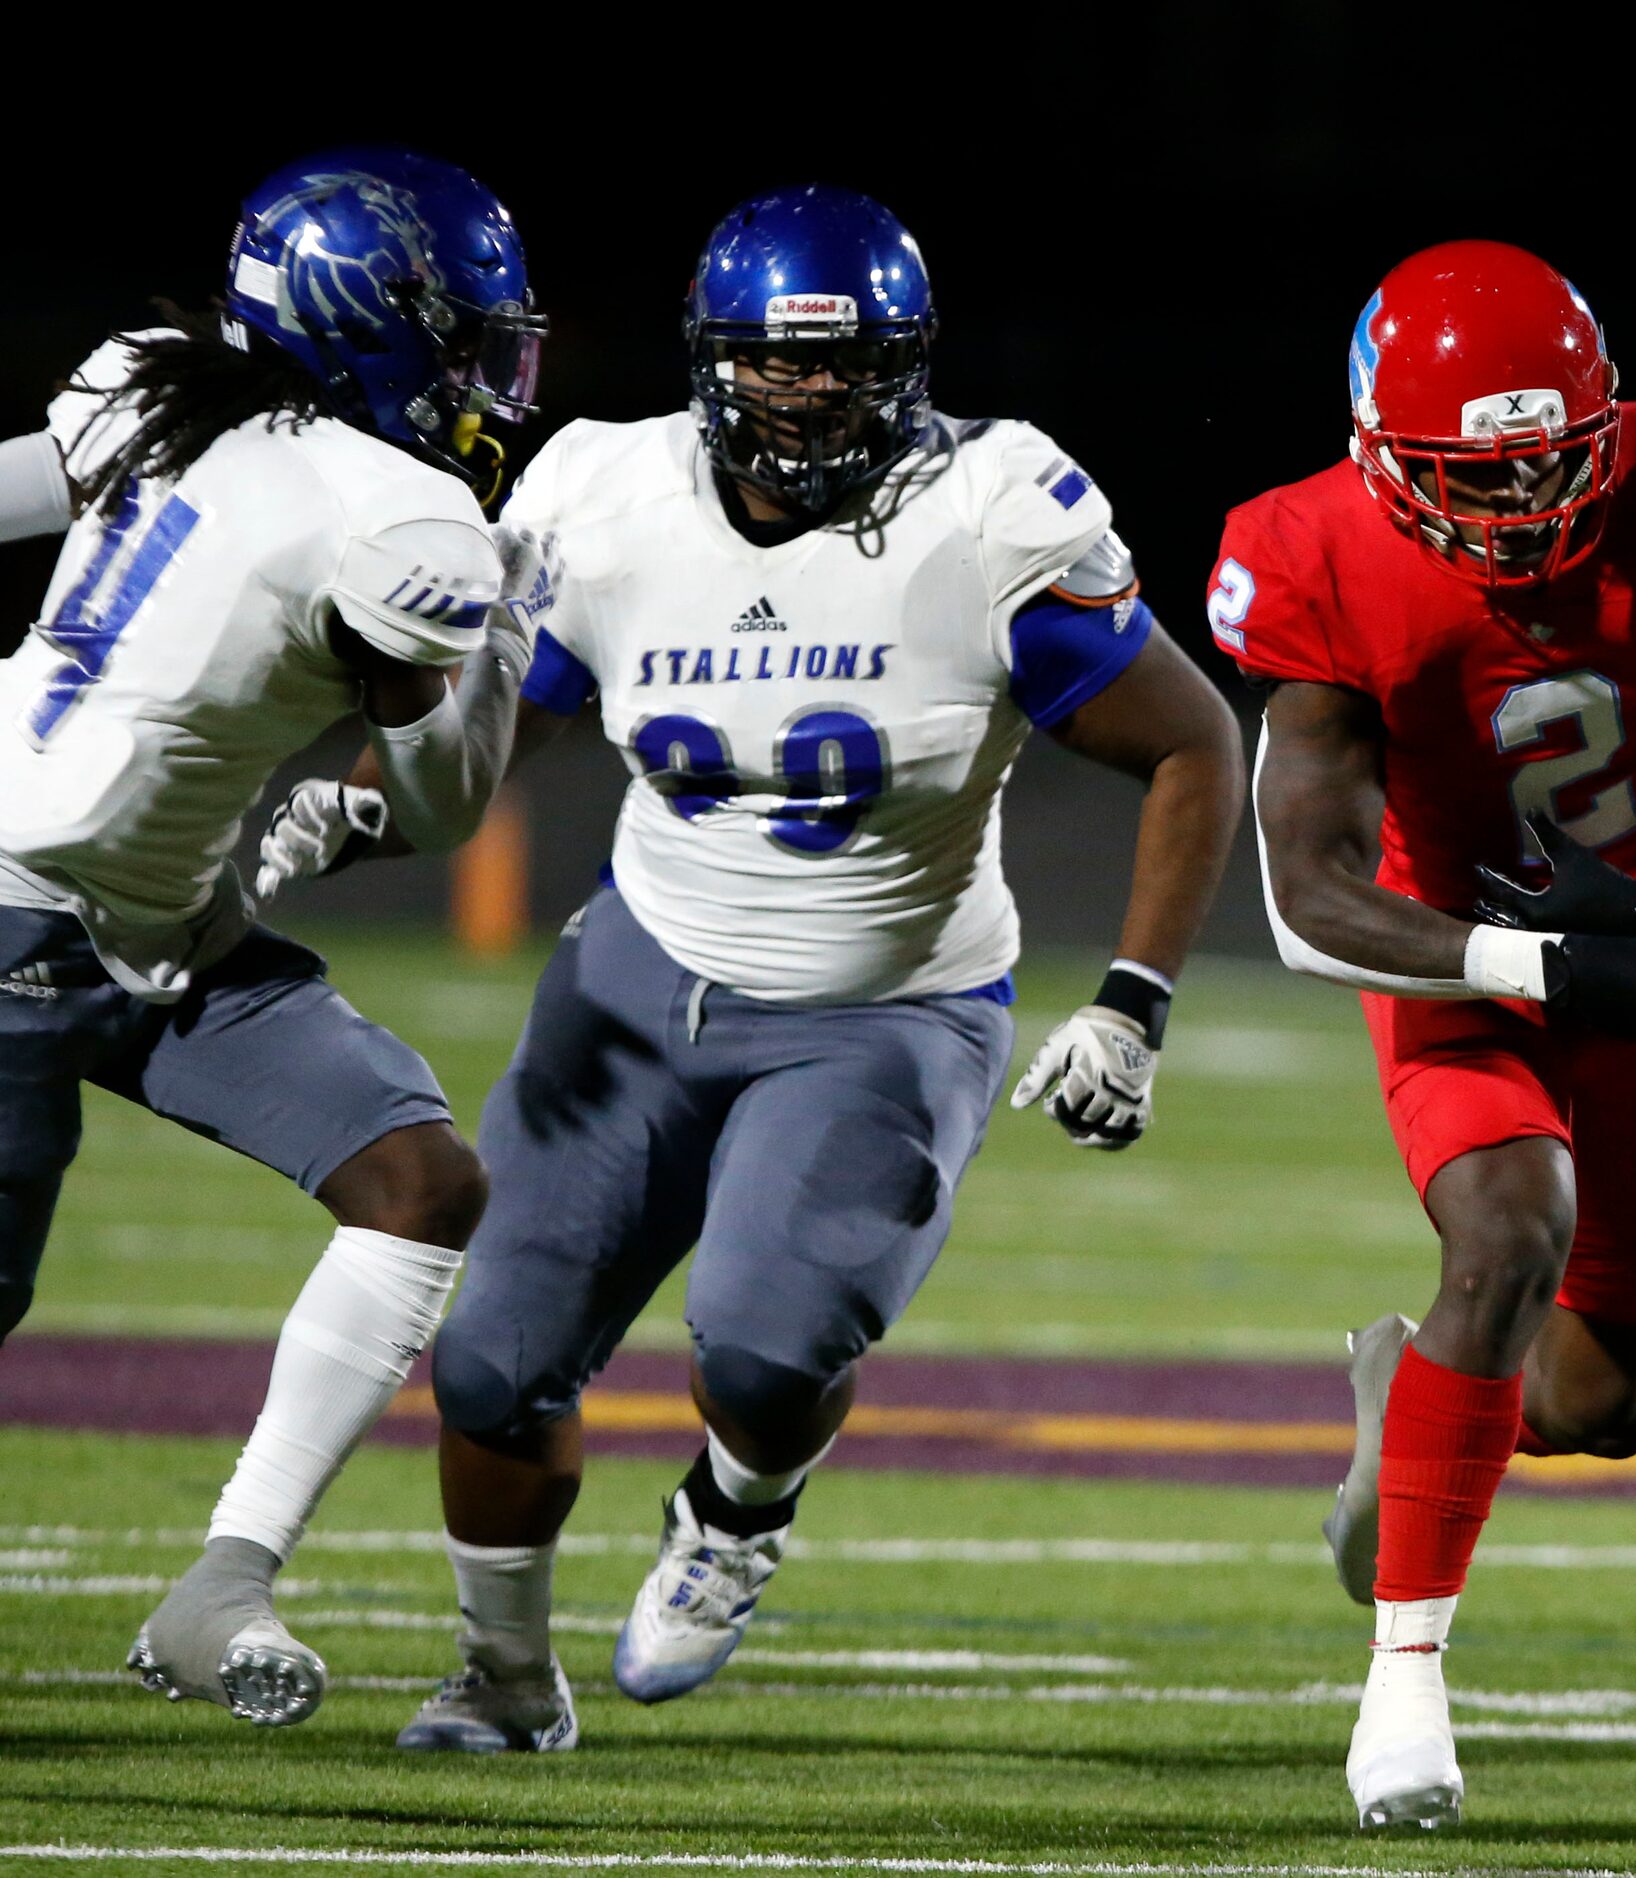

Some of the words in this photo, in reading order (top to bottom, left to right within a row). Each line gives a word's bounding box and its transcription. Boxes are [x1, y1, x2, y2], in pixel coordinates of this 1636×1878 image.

[787, 299, 837, 314] Riddell
[1504, 393, 1525, 415] X
[1207, 556, 1256, 655] 2
[730, 618, 788, 633] adidas
[634, 643, 898, 687] STALLIONS
